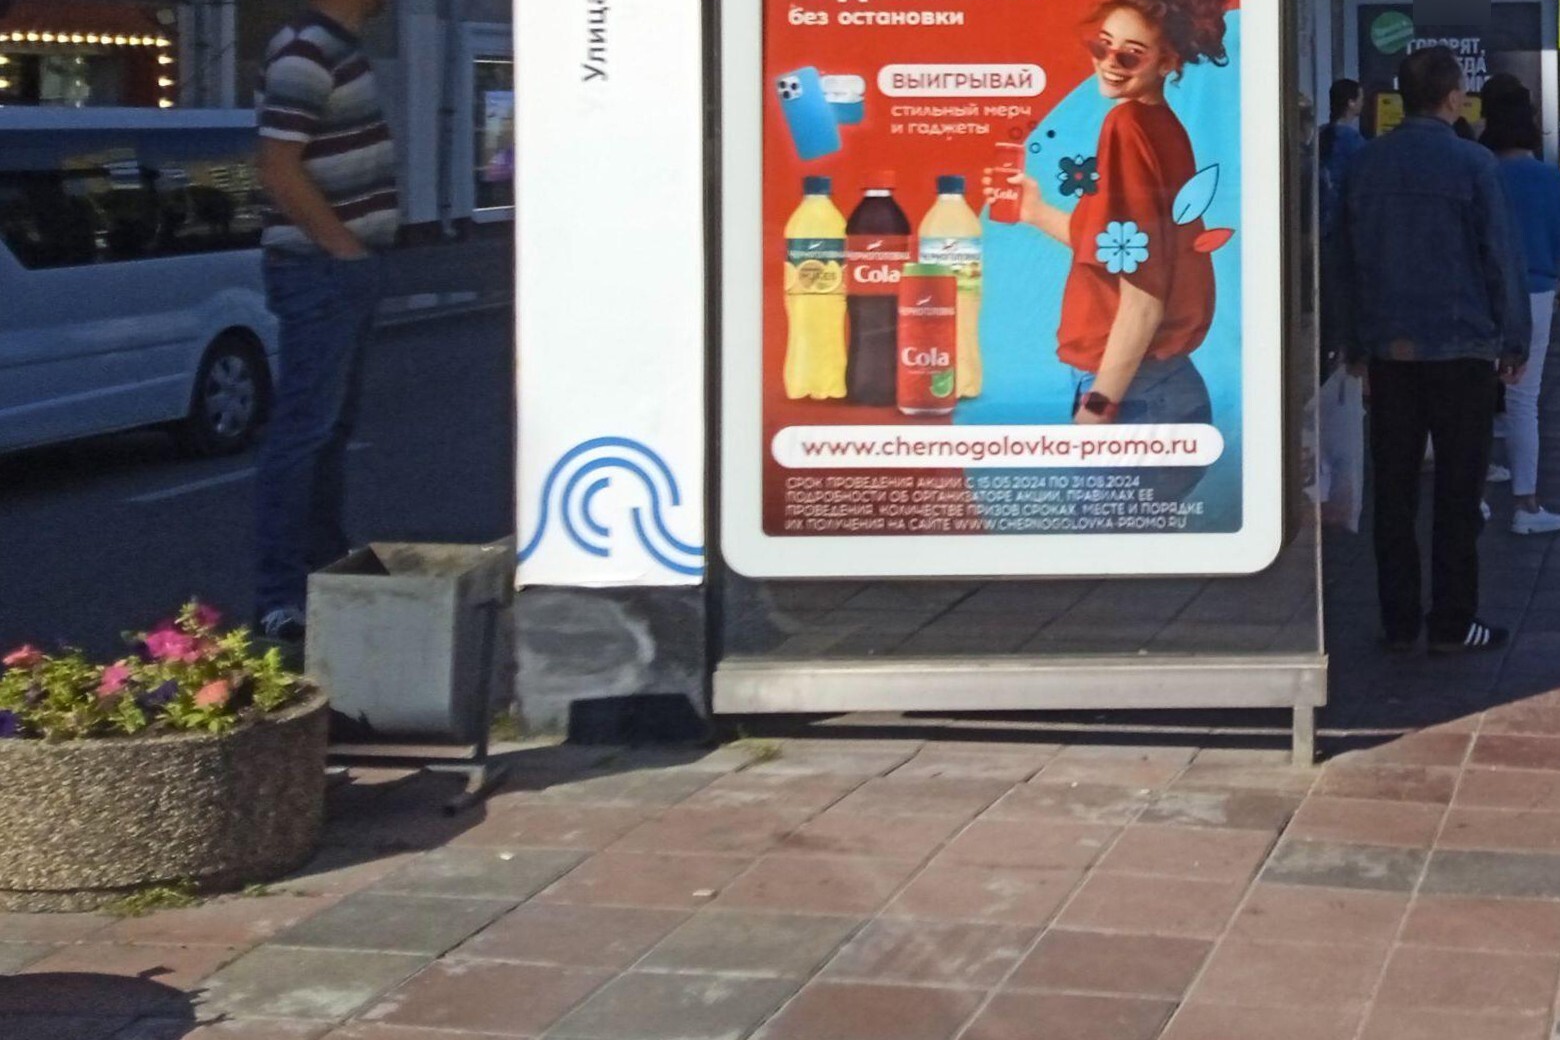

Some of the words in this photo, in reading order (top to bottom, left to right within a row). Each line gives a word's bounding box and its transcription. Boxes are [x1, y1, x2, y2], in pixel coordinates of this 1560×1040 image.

[788, 5, 829, 26] без
[838, 10, 965, 26] остановки
[892, 66, 1034, 90] ВЫИГРЫВАЙ
[890, 102, 980, 118] стильный
[984, 106, 1032, 121] мерч
[891, 124, 903, 135] и
[909, 123, 990, 138] гаджеты
[853, 265, 901, 283] Cola
[902, 346, 950, 366] Cola
[802, 435, 1197, 461] www.chernogolovka-promo.ru
[786, 476, 823, 489] СРОК
[1048, 476, 1070, 488] ПО
